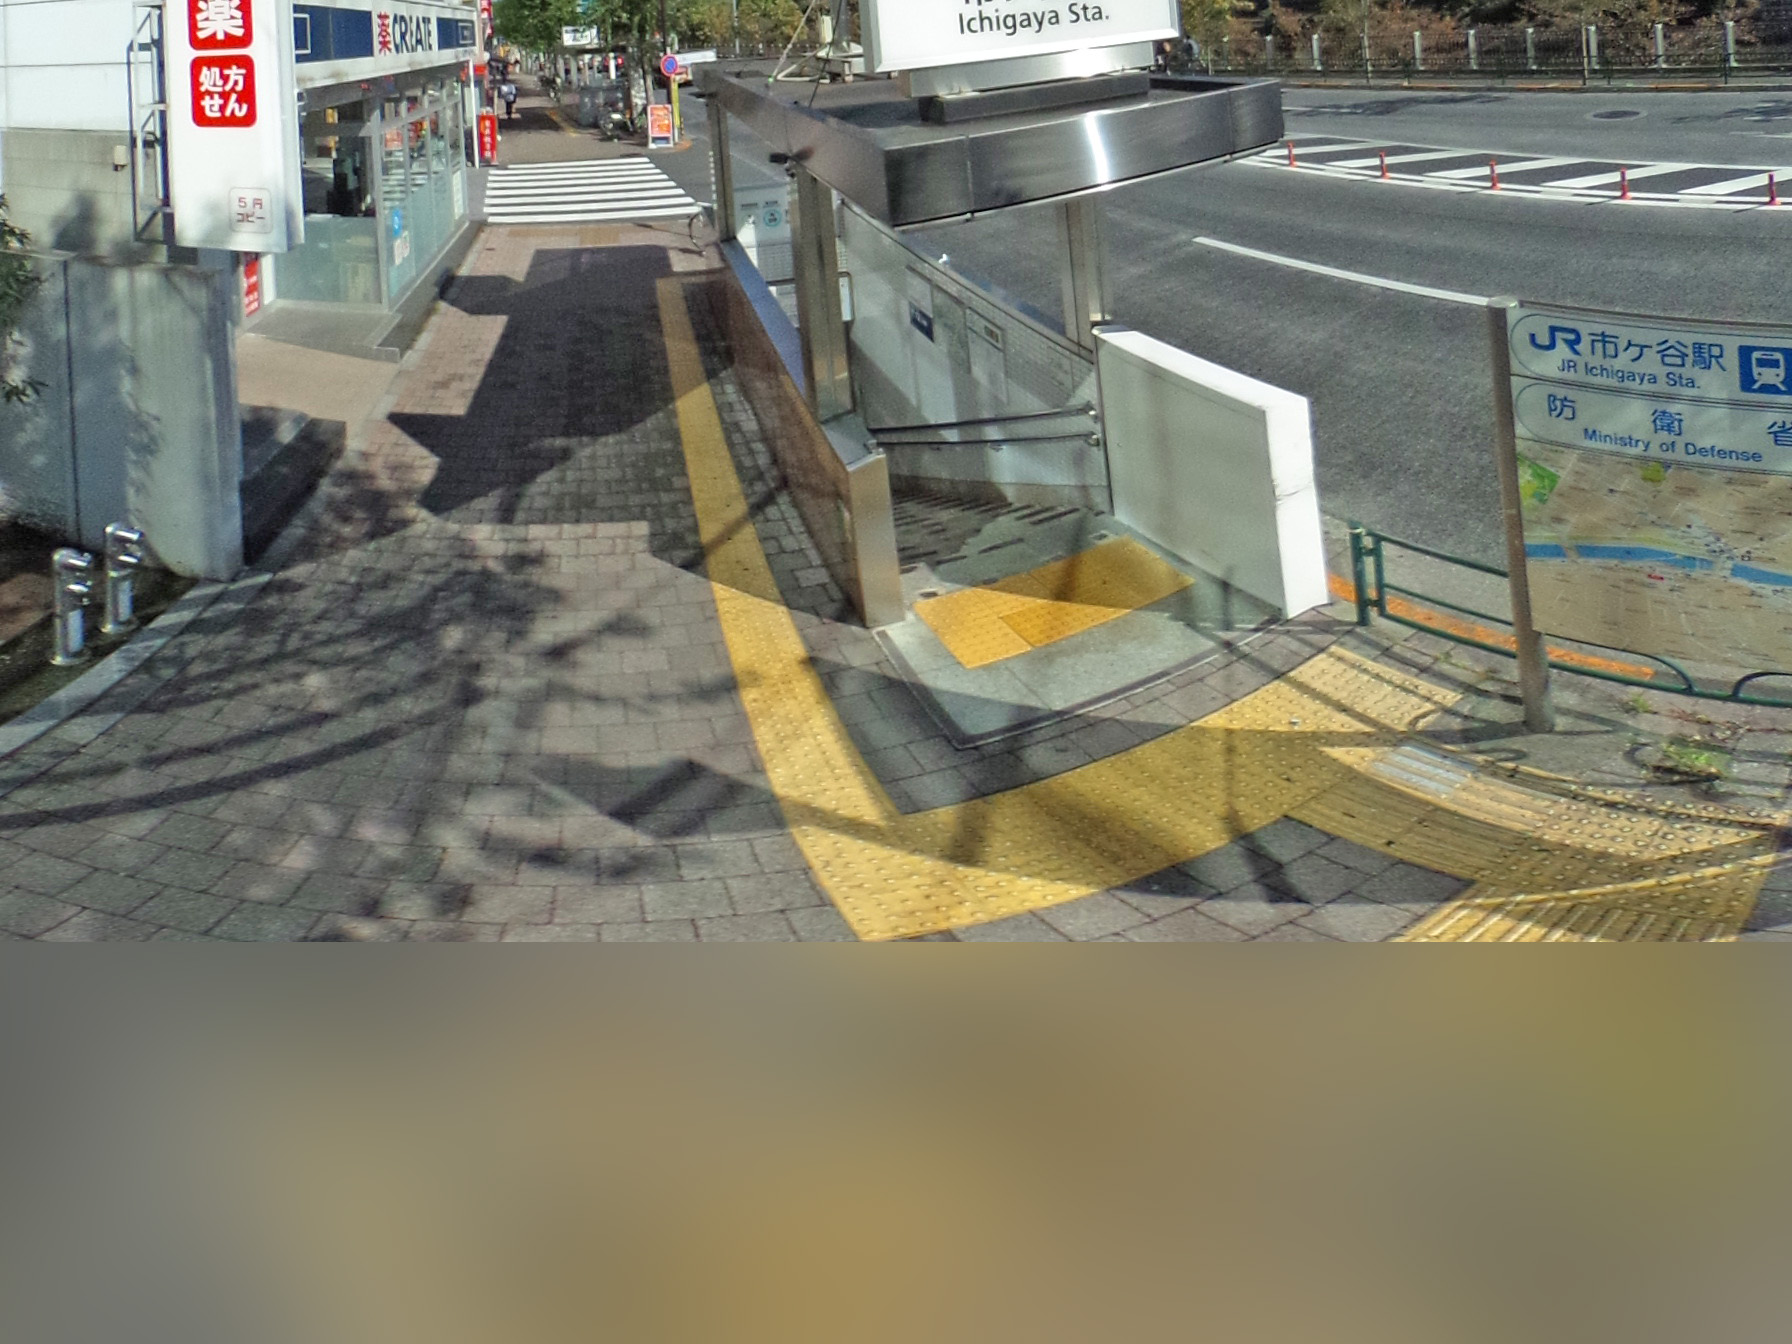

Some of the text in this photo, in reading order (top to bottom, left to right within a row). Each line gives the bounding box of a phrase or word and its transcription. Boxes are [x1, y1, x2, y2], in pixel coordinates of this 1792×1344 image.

[377, 11, 433, 56] 薬 CREATE
[958, 2, 1110, 37] Ichigaya Sta.
[198, 65, 246, 93] 処方
[199, 93, 248, 118] せん
[235, 210, 266, 224] コピー
[1556, 358, 1702, 390] JR Ichigaya Sta.
[1582, 428, 1764, 464] Ministry of Defense
